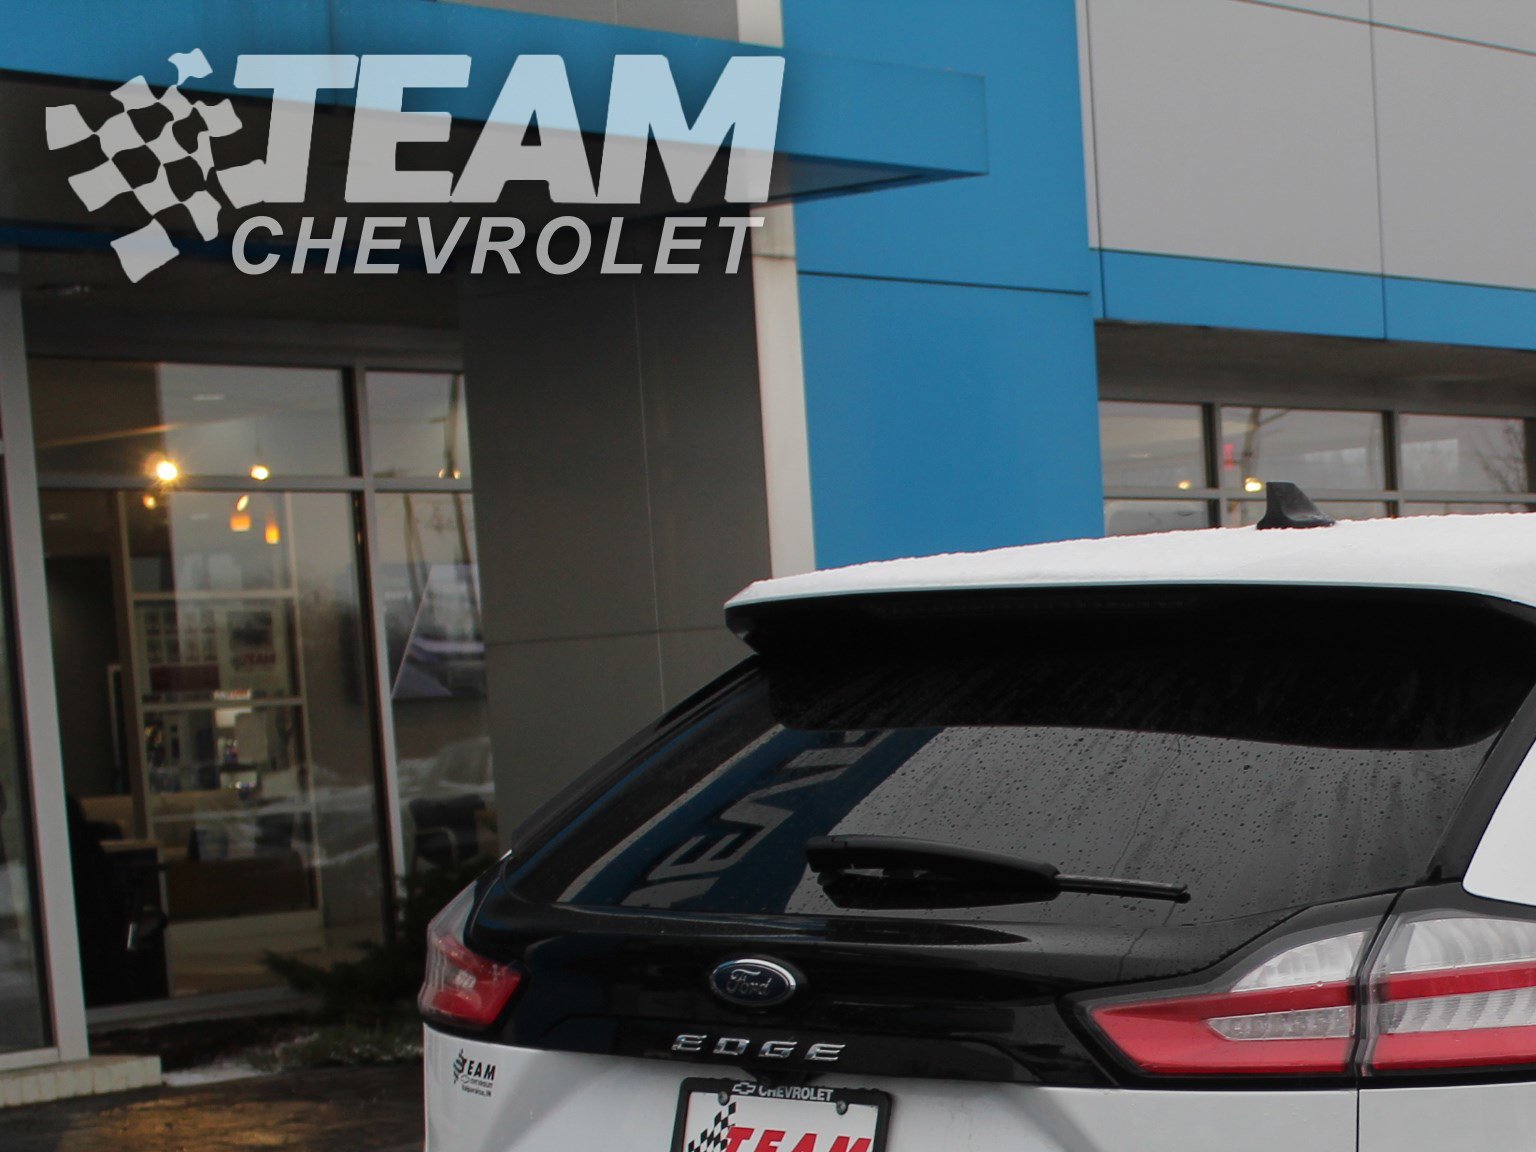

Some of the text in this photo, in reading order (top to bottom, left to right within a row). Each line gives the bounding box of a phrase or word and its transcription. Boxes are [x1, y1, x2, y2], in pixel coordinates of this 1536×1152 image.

[726, 968, 773, 996] Ford
[671, 1034, 847, 1062] EDGE
[459, 1058, 497, 1081] TEAM
[758, 1084, 835, 1102] CHEVROLET
